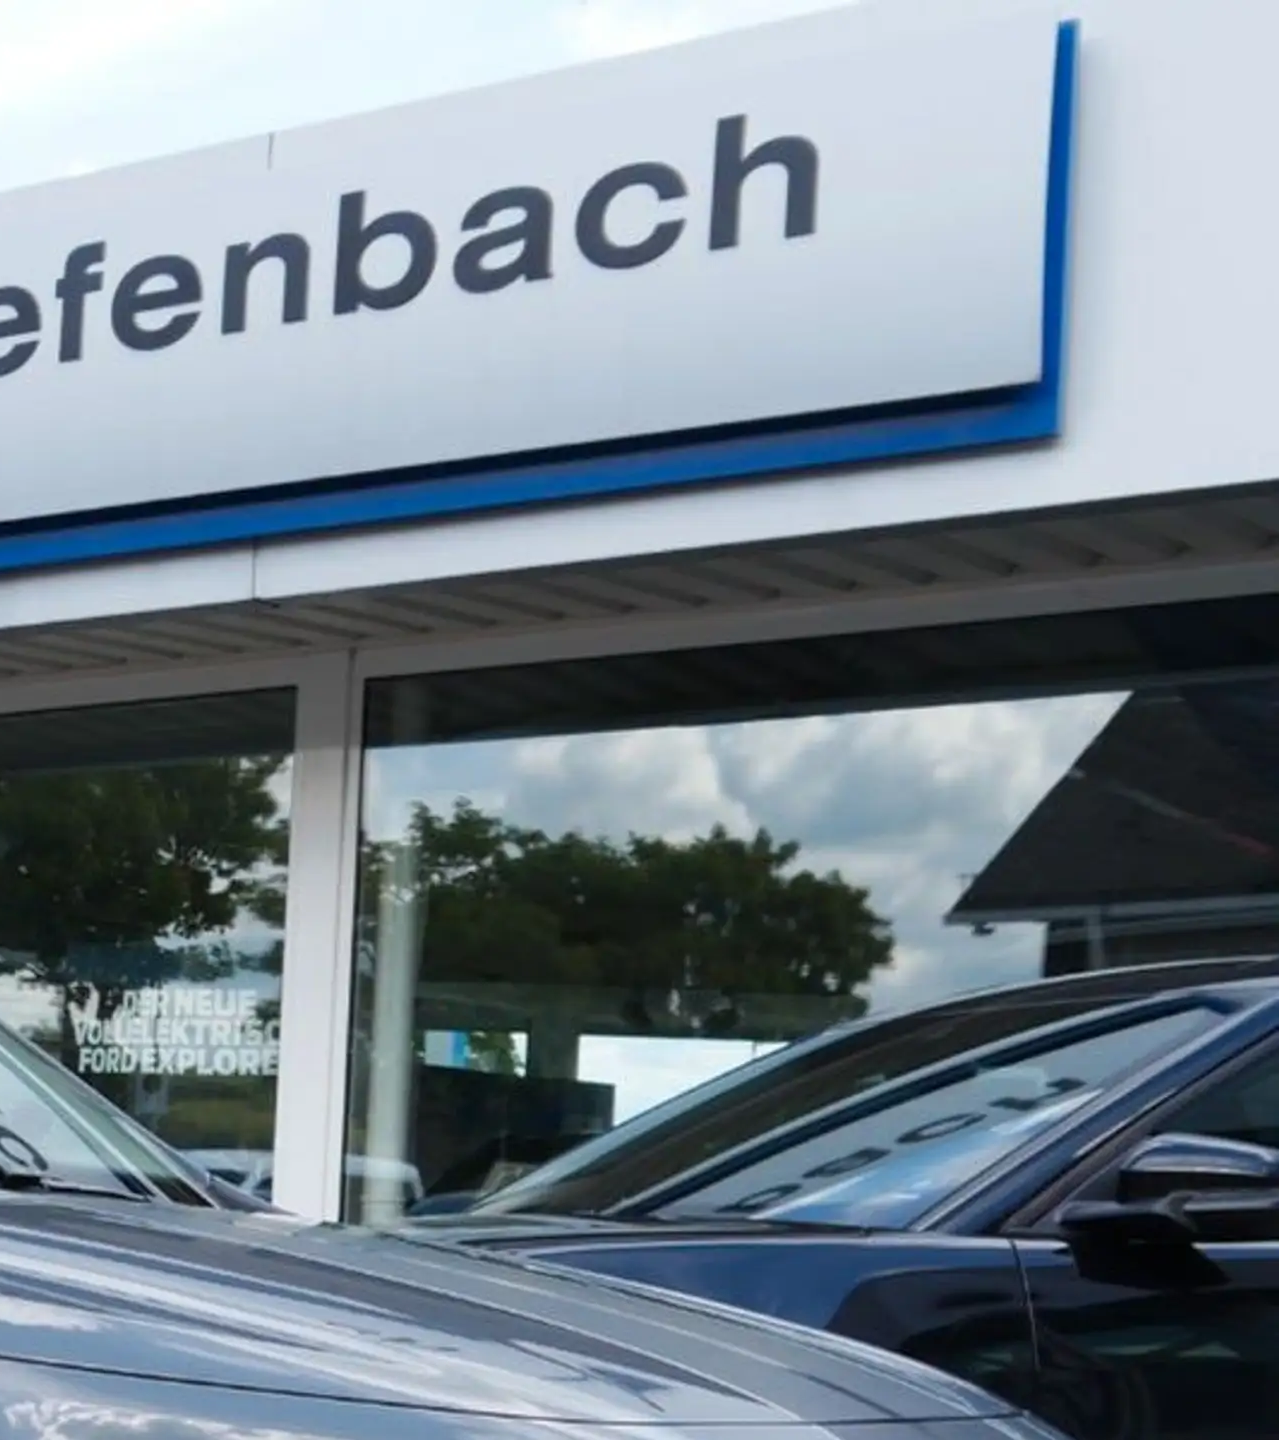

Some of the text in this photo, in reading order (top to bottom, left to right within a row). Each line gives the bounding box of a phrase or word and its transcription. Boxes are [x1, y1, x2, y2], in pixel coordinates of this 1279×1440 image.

[123, 987, 257, 1018] DER NEUE
[78, 1047, 138, 1074] FORD
